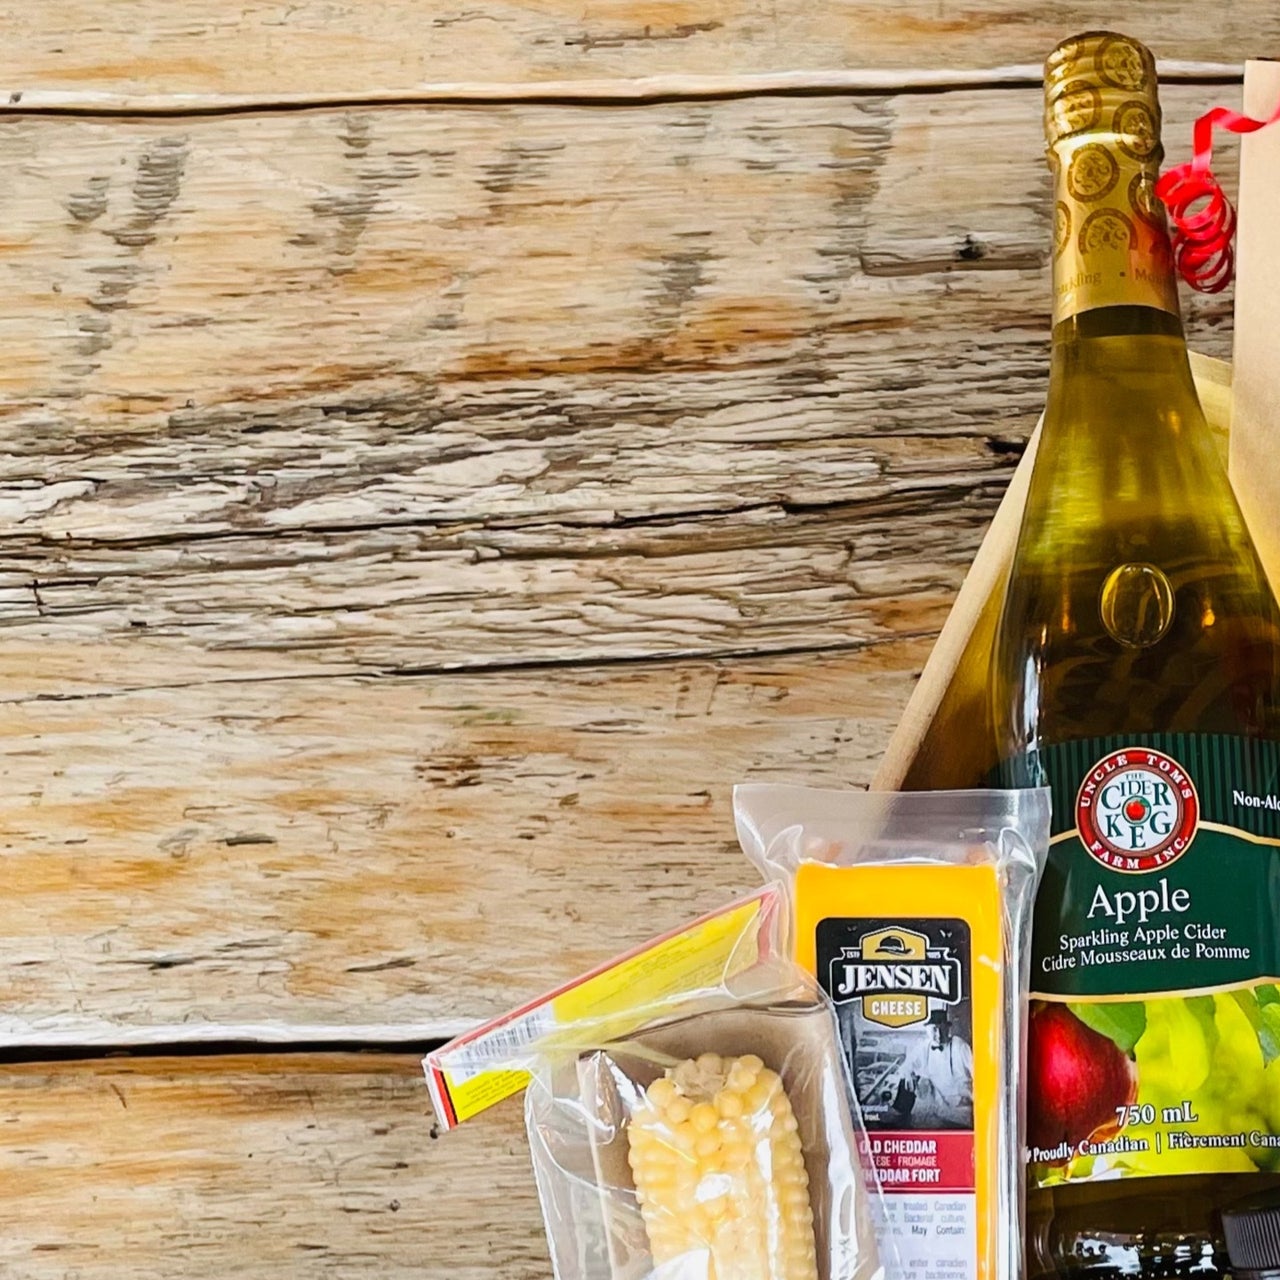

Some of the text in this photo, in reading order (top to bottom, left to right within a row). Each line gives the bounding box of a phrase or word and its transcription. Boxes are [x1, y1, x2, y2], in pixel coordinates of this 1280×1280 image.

[1081, 754, 1192, 807] UNCLE TOM'S
[1101, 780, 1171, 809] CIDER
[1106, 811, 1171, 848] KEG
[1091, 837, 1188, 869] FARM INC.
[1087, 878, 1190, 924] Apple
[1060, 924, 1226, 953] Sparkling Apple Cider
[1042, 943, 1250, 972] Cidre Mousseaux de Pomme
[838, 965, 952, 995] JENSEN
[872, 1001, 921, 1016] CHEESE
[1115, 1101, 1199, 1126] 750 mL
[885, 1140, 936, 1153] CHEDDAR
[898, 1156, 936, 1166] FROMAGE
[1032, 1145, 1074, 1162] Proudly
[1078, 1138, 1149, 1155] Canadian
[1168, 1131, 1246, 1149] Fièrement
[911, 1169, 941, 1182] FORT
[912, 1226, 927, 1236] May
